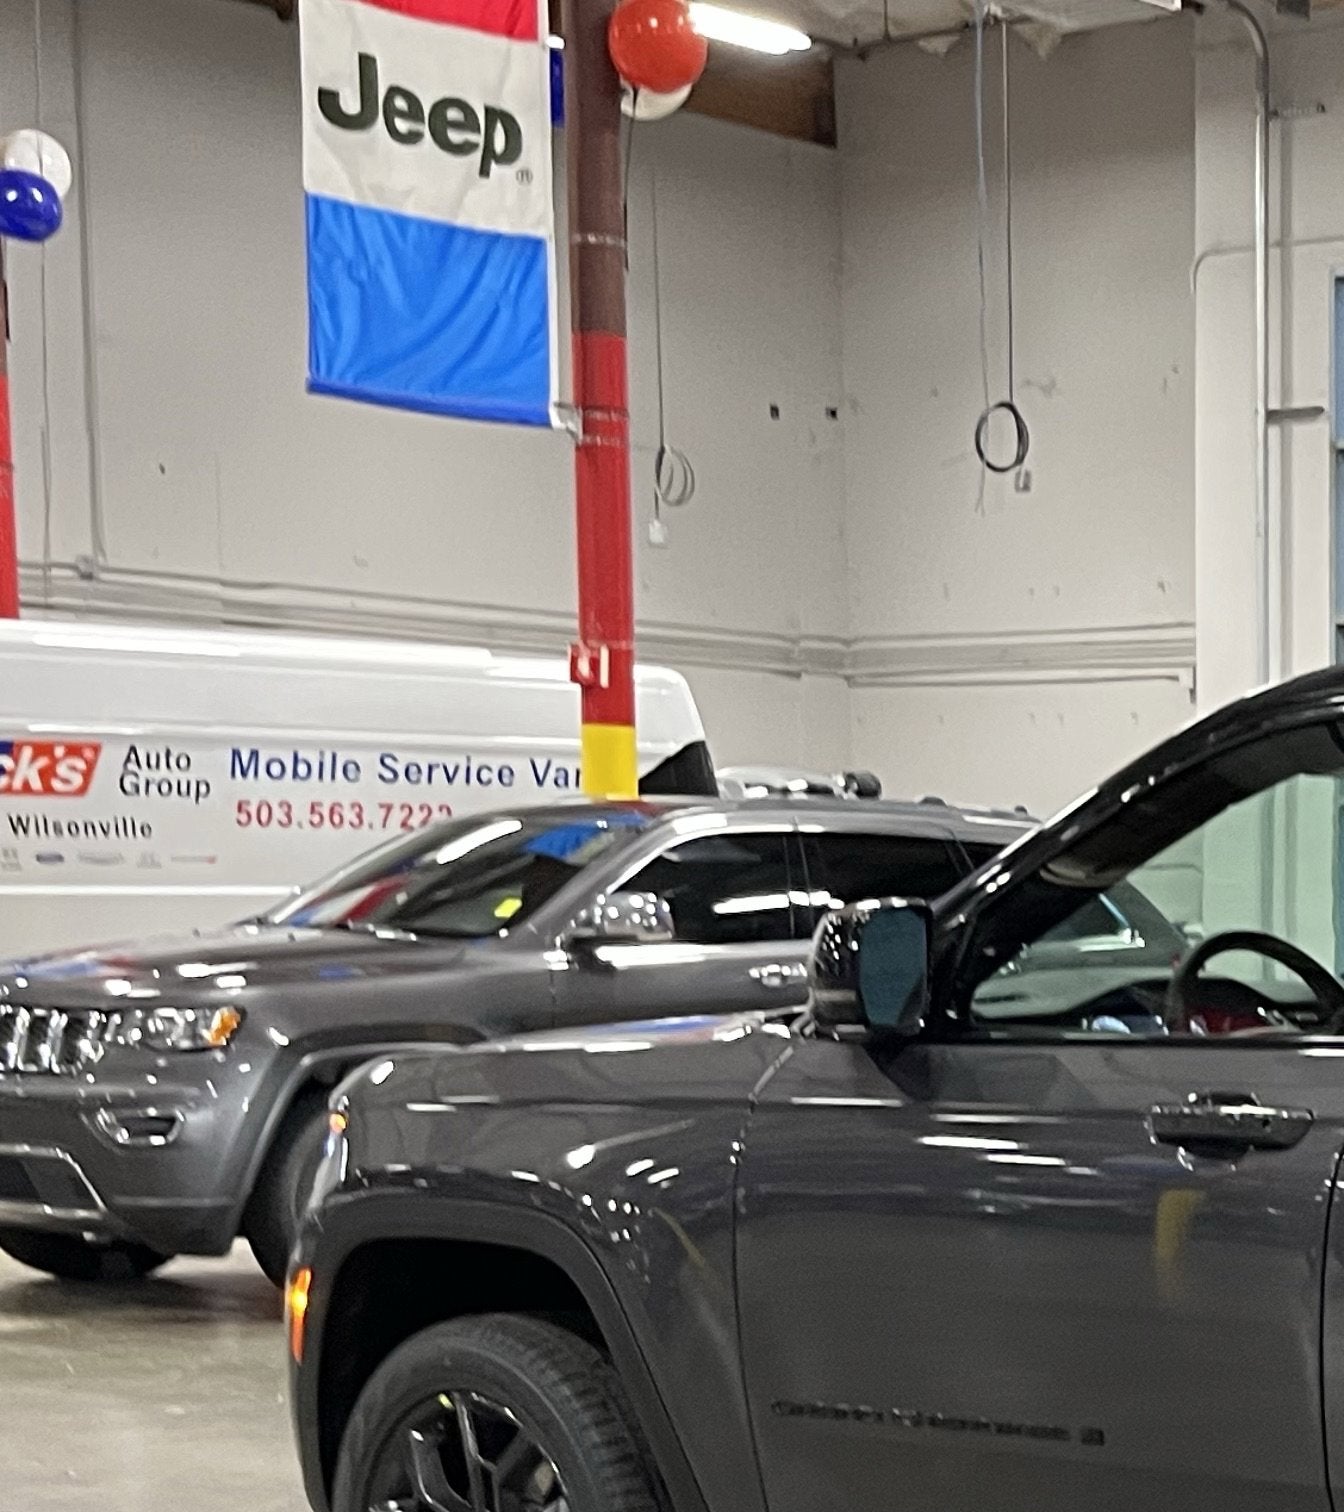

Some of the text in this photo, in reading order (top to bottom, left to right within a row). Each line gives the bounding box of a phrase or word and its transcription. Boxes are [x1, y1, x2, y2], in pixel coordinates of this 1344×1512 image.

[317, 51, 523, 179] Jeep
[122, 743, 192, 773] Auto
[229, 747, 362, 784] Mobile
[377, 751, 515, 788] Service
[119, 769, 212, 805] Group
[6, 812, 153, 841] Wilsonville
